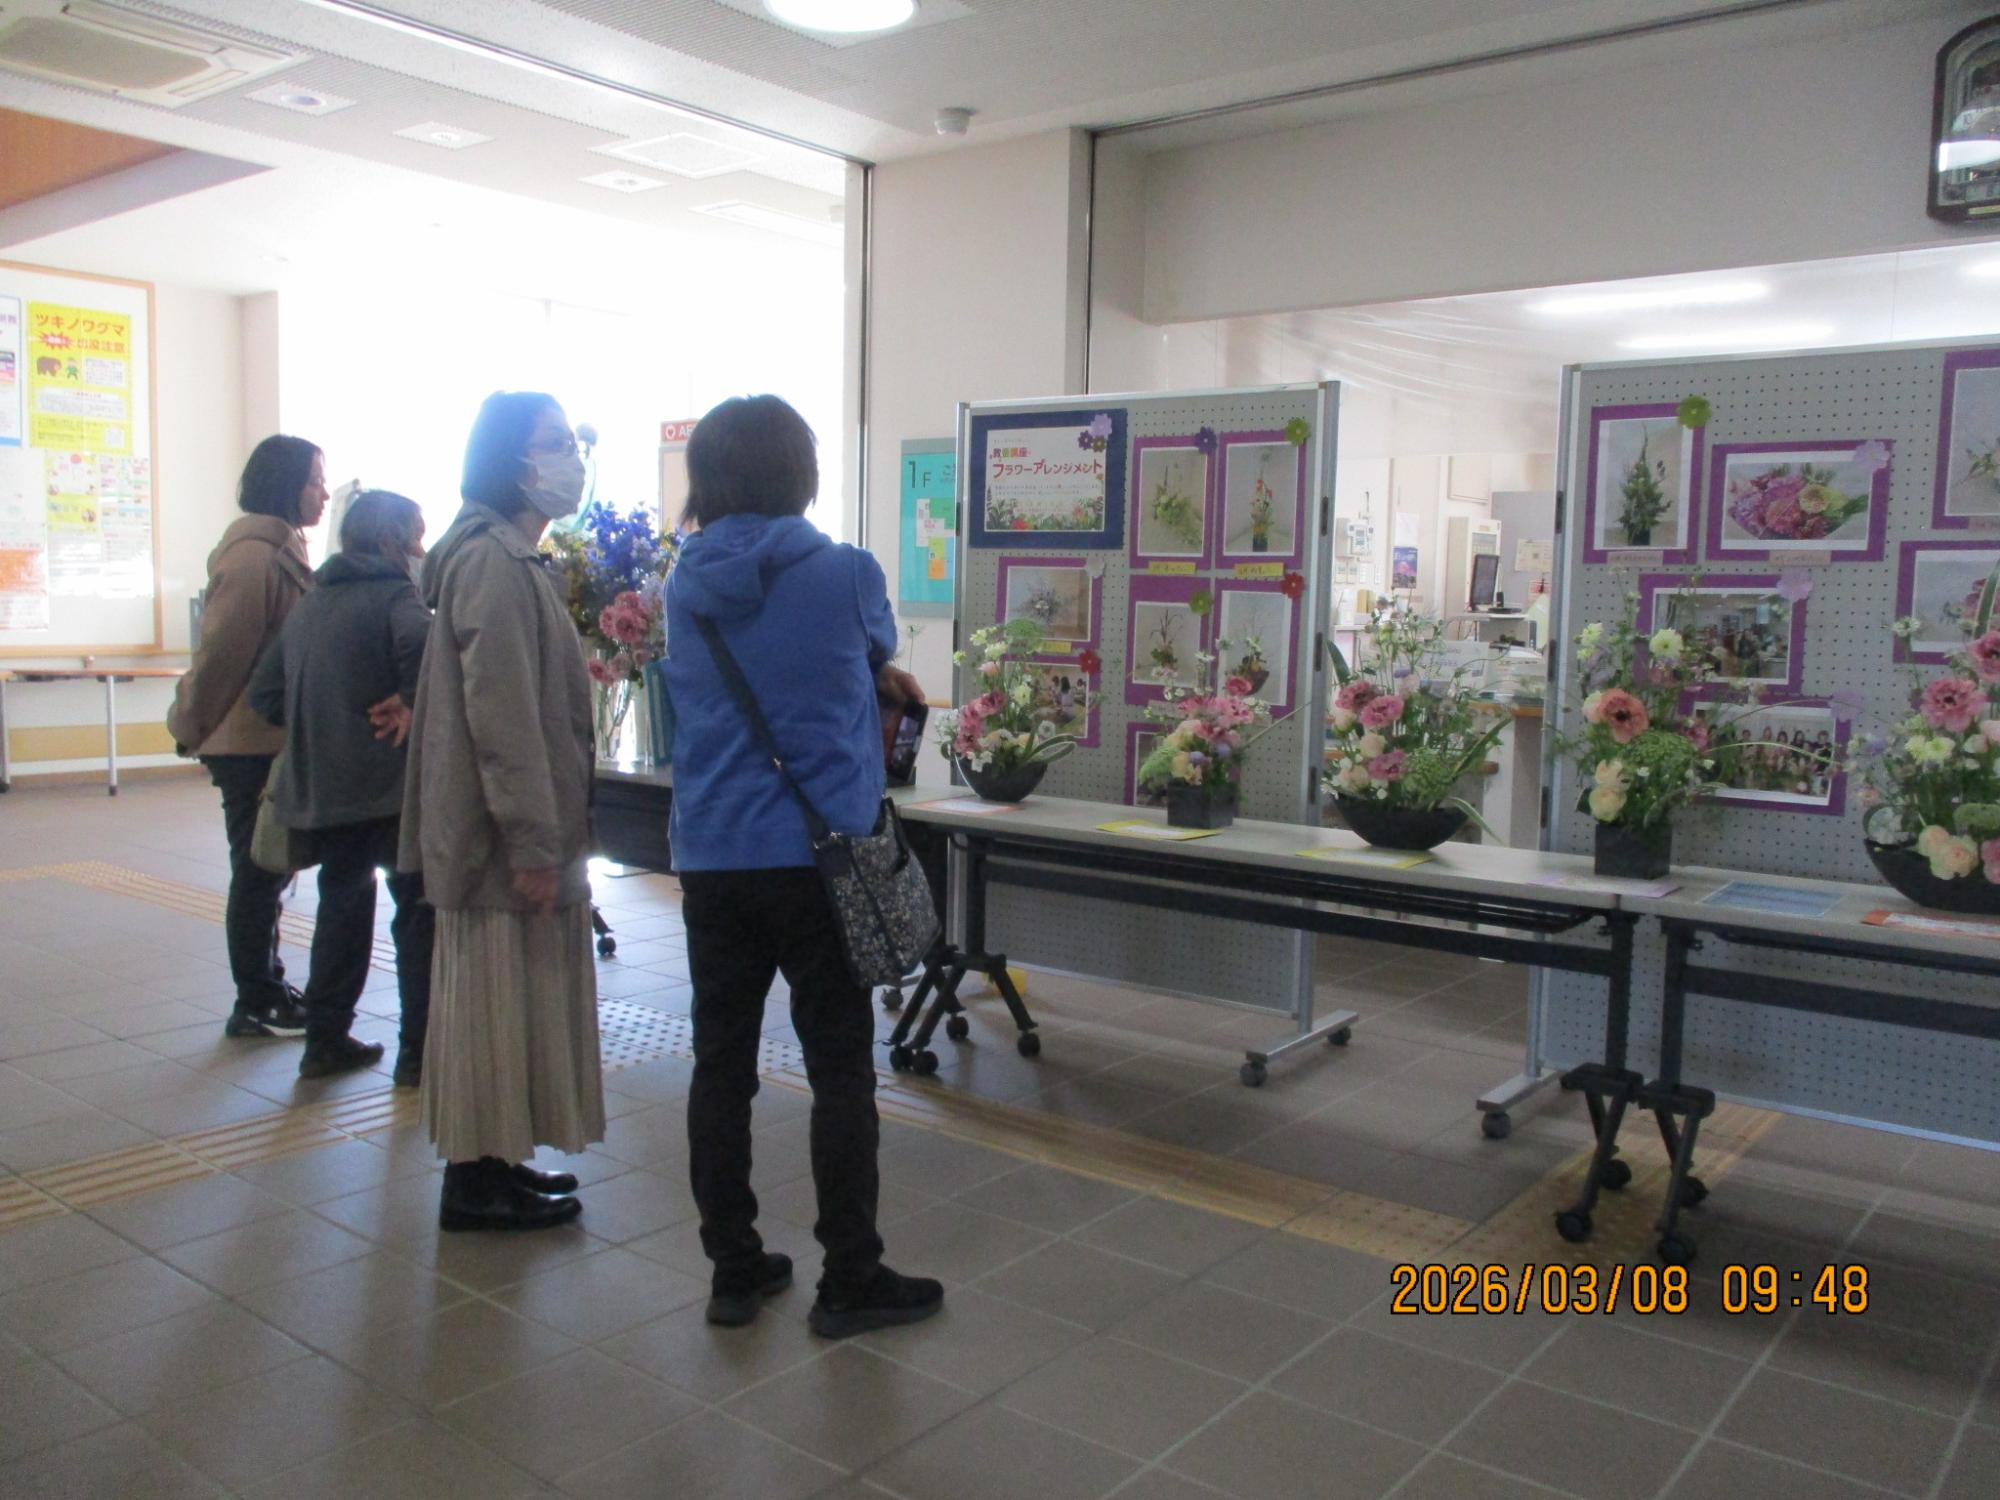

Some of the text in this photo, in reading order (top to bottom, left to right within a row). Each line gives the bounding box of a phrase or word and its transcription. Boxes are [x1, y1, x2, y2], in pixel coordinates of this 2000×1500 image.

[36, 312, 125, 337] ツキノワグマ
[679, 423, 697, 439] AE
[992, 458, 1103, 479] フラワーアレンジメント
